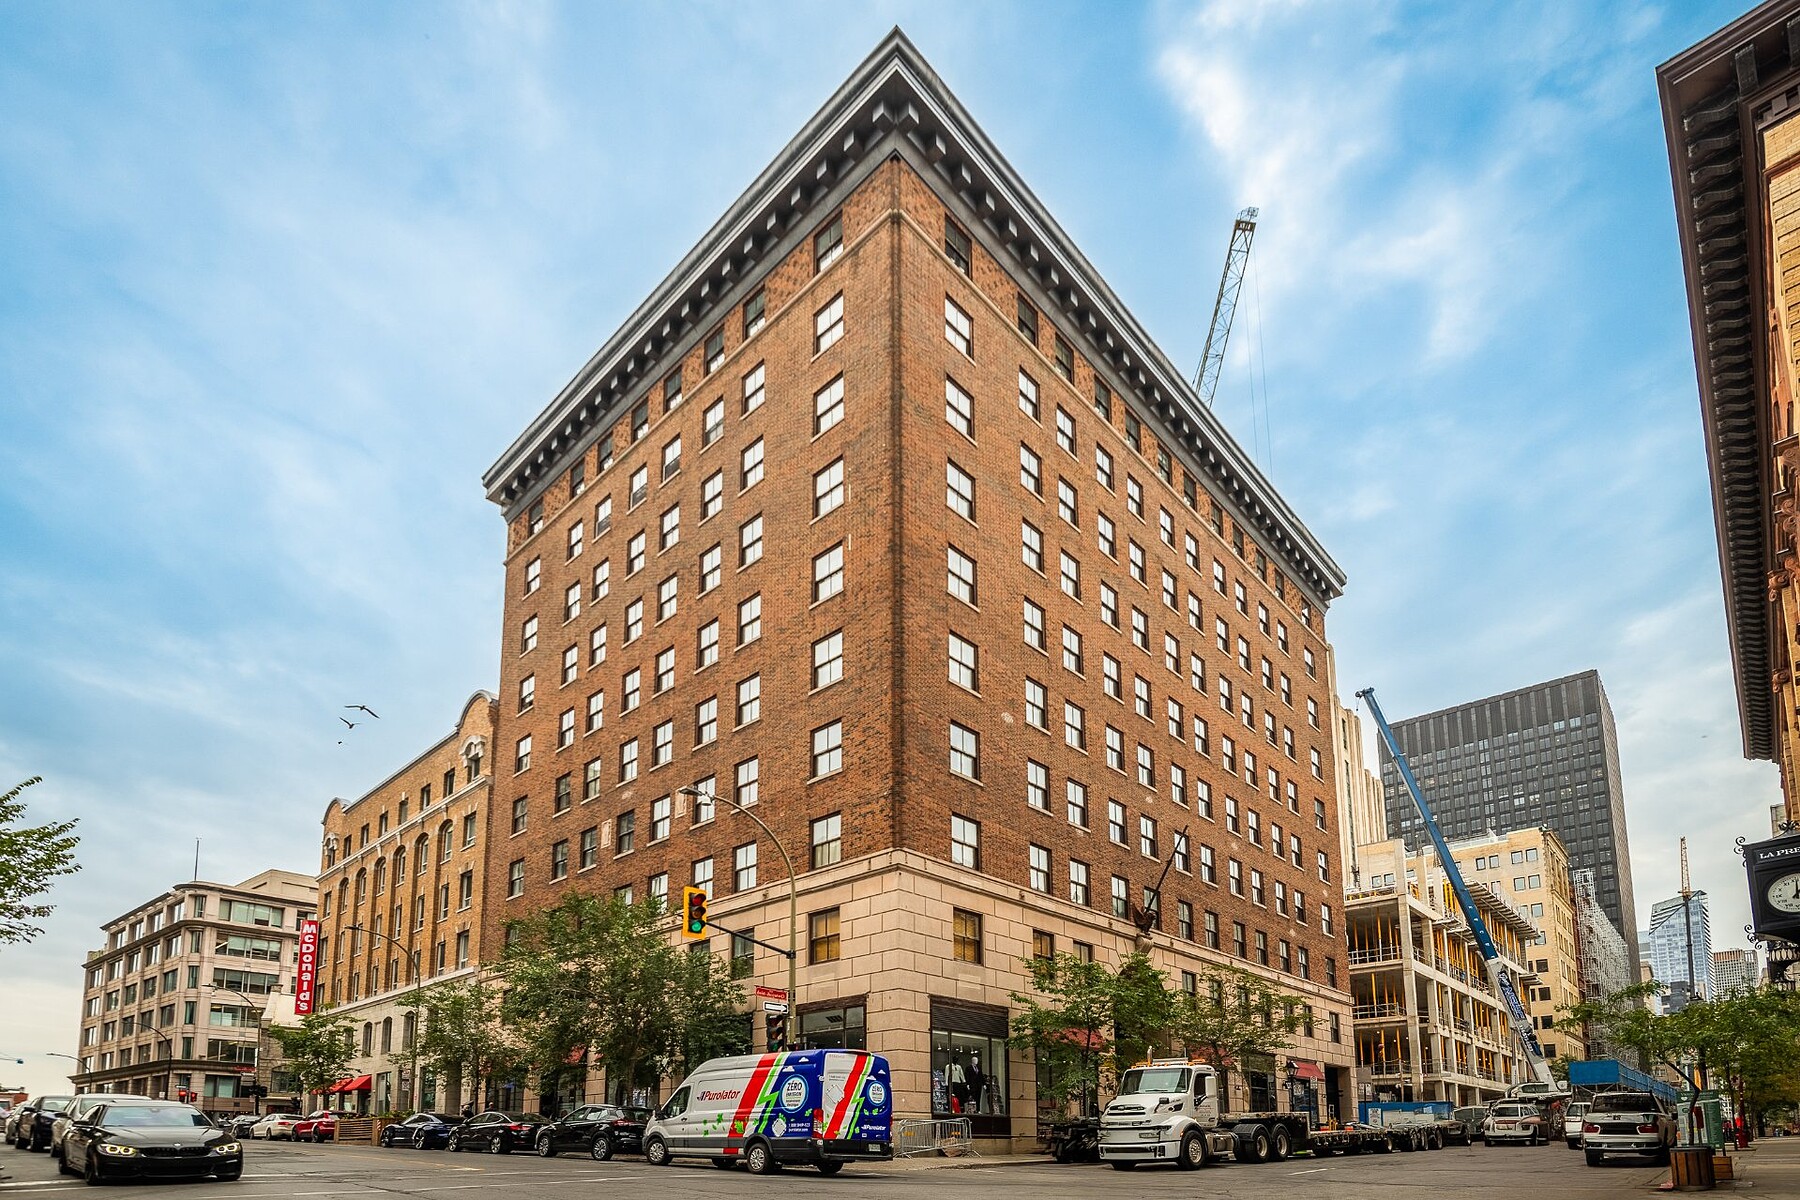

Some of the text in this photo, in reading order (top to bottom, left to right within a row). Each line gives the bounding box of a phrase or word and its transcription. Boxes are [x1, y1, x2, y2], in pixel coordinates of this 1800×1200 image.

[297, 924, 317, 1011] McDonald's
[786, 1080, 803, 1092] ZÉRO
[704, 1090, 741, 1101] Purolator
